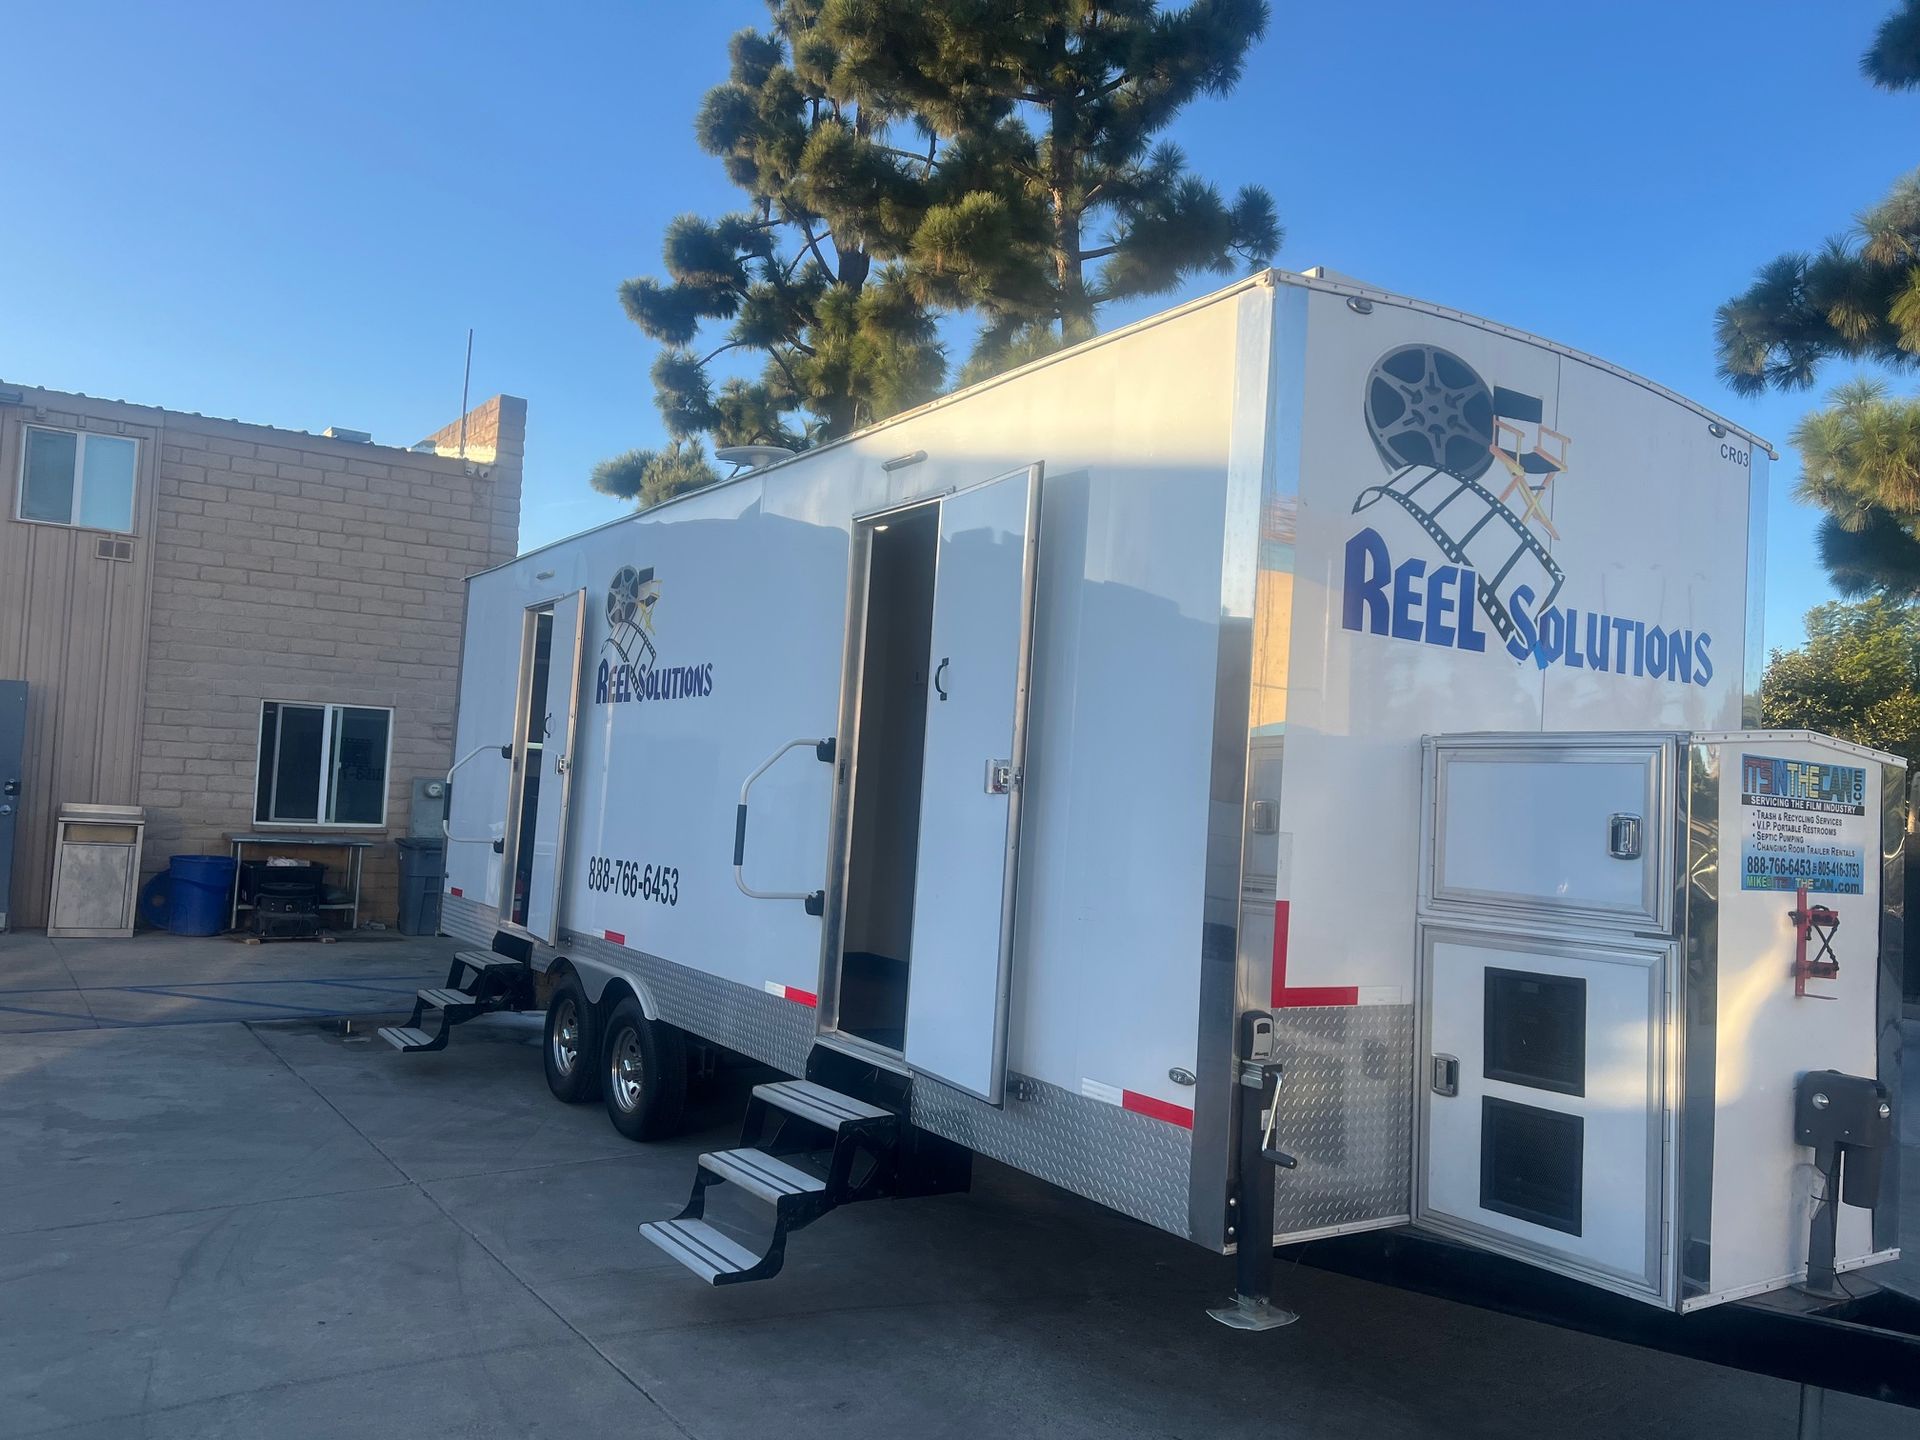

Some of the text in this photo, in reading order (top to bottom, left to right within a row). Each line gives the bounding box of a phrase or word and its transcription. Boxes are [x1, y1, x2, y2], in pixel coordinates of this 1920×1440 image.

[1720, 443, 1749, 468] CR03
[1342, 527, 1713, 687] REEL SOLUTIONS
[596, 658, 713, 704] REEL SOLUTIONS
[1750, 795, 1857, 814] SERVICING THE FILM INDUSTRY
[1756, 809, 1843, 827] TRASH & RECYCLING SERVICES
[1756, 831, 1804, 844] SEPTIC PUMPING
[1773, 822, 1802, 833] PORTABLE
[1802, 824, 1837, 836] RESTROOMS
[1756, 842, 1856, 858] CHANGING ROOM TRAILER RENTALS
[1747, 856, 1811, 876] 888-766-6453
[1817, 861, 1860, 879] 805-416-3753
[588, 855, 679, 907] 888-766-6453
